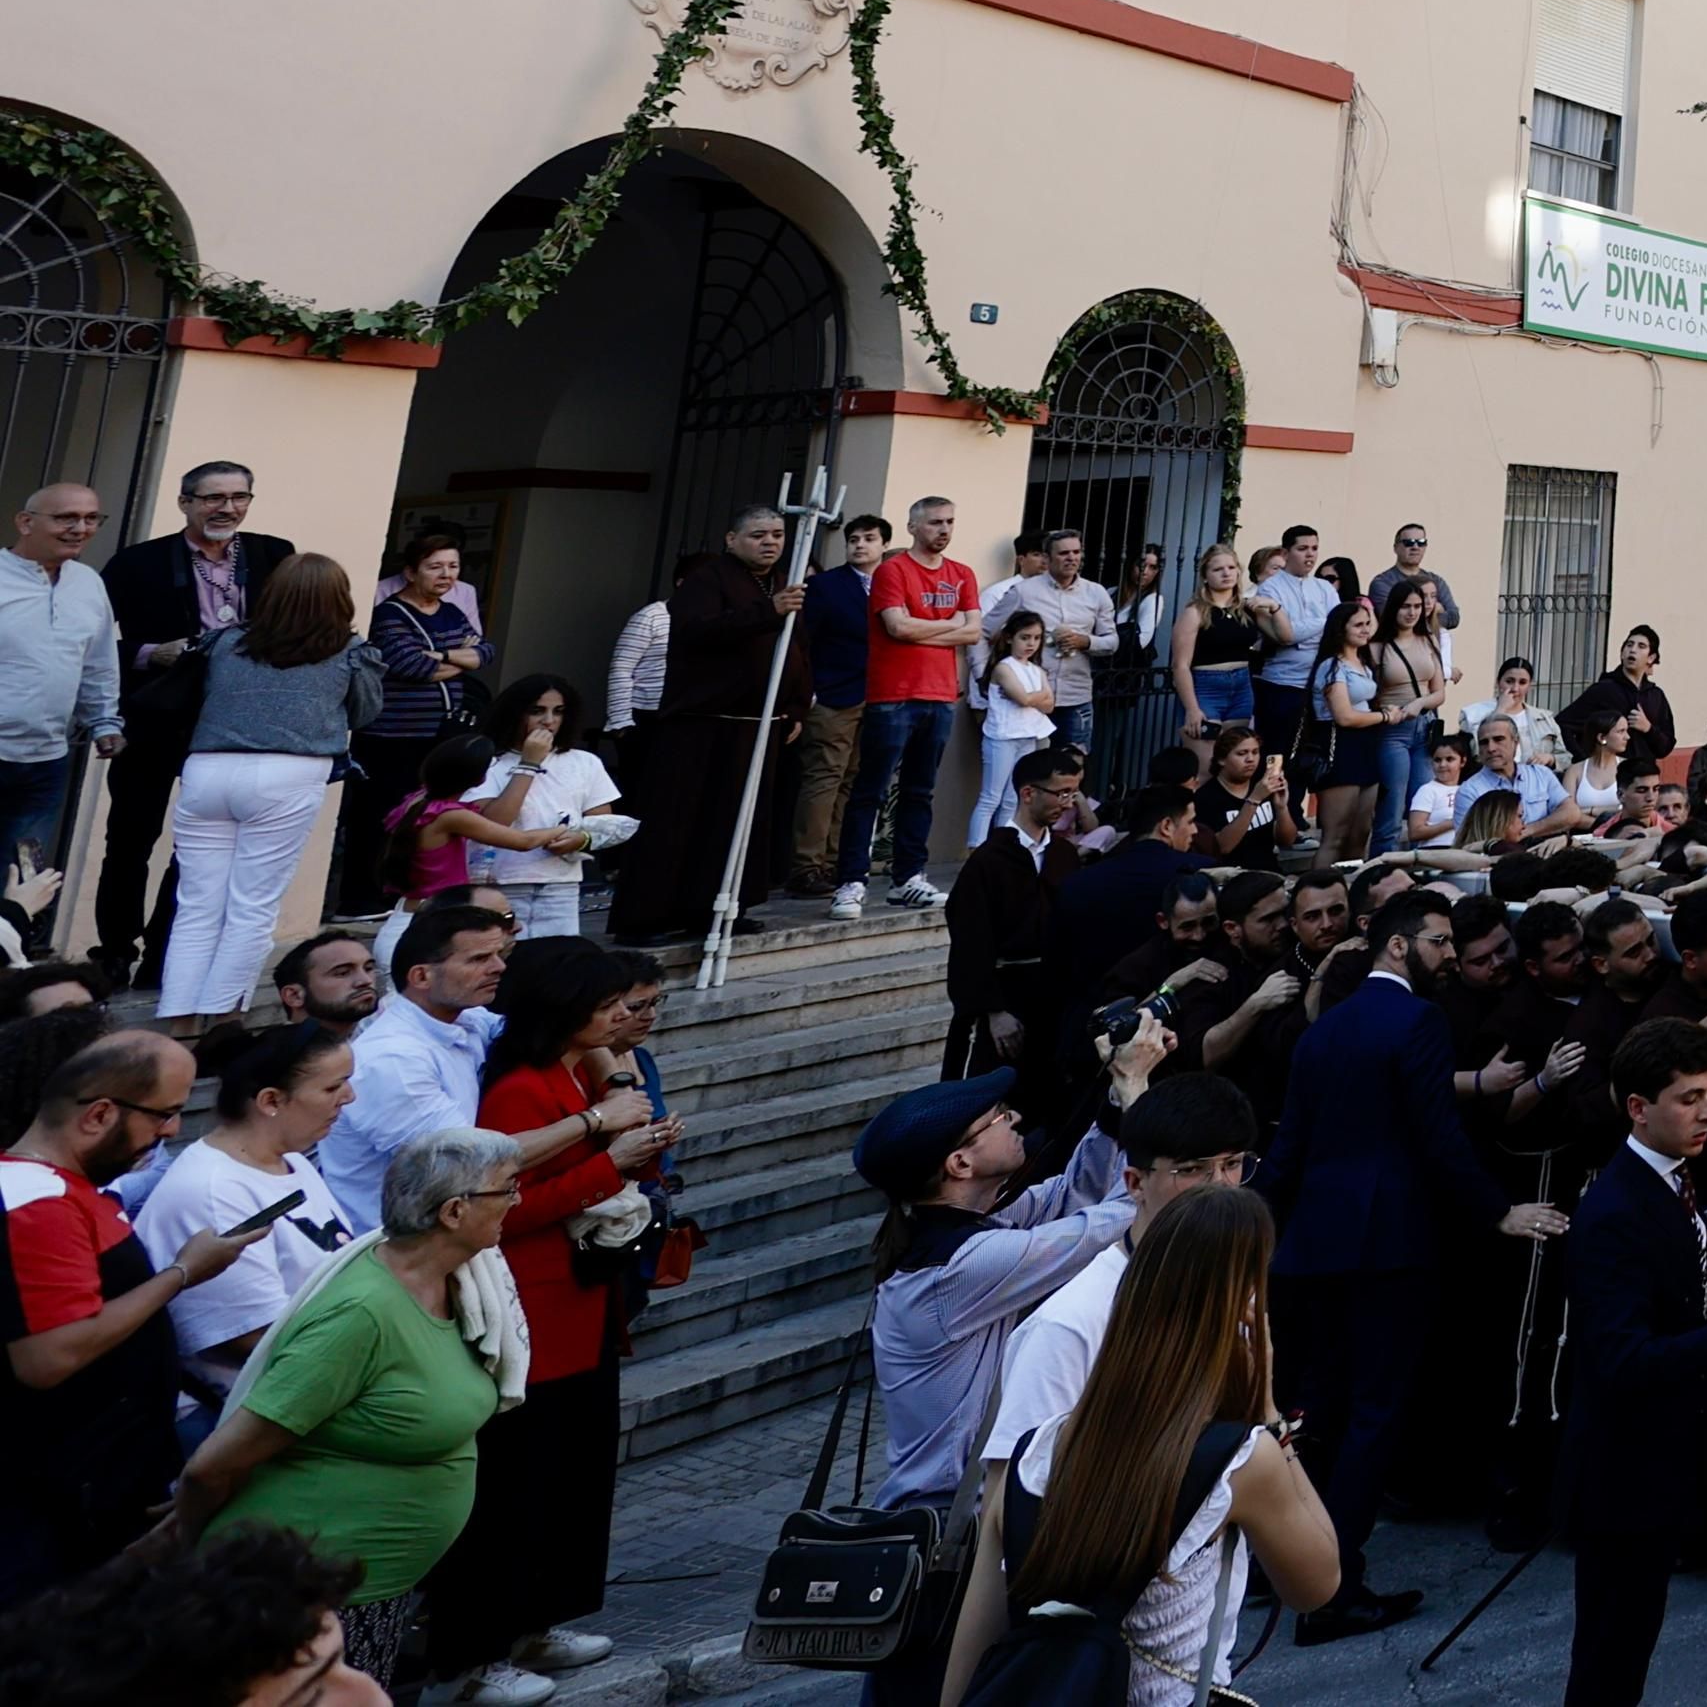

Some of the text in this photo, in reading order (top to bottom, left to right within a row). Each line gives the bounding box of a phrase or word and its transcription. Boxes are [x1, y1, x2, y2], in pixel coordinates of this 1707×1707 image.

[752, 9, 767, 22] DE
[768, 13, 785, 27] LAS
[786, 20, 823, 35] ALMAS
[1606, 242, 1649, 264] COLEGIO
[1606, 262, 1688, 313] DIVINA
[980, 305, 990, 322] 5
[796, 1629, 828, 1655] HAO
[831, 1630, 864, 1655] HUA
